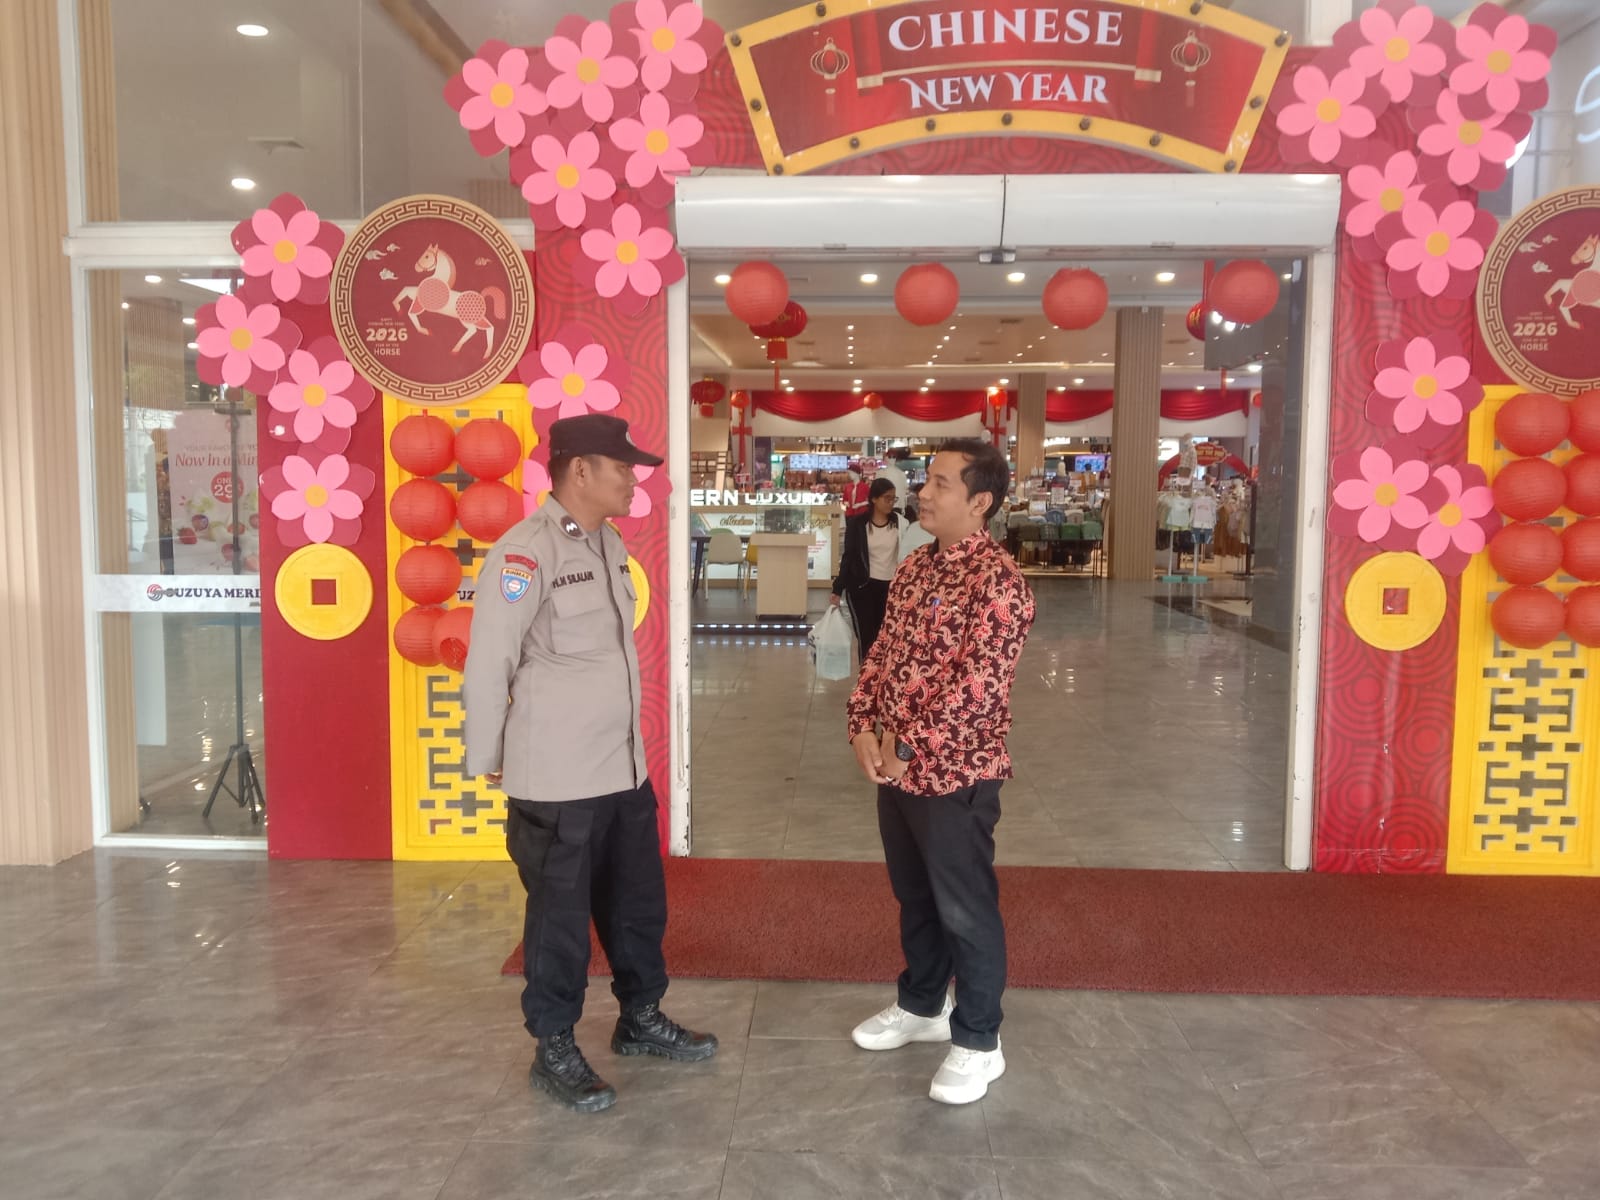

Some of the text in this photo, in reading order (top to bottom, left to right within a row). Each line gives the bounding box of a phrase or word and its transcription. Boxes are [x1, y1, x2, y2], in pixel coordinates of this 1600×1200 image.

[888, 8, 1123, 51] CHINESE
[900, 71, 1109, 111] NEW YEAR
[366, 328, 408, 341] 2026
[1513, 322, 1558, 336] 2026
[374, 348, 400, 356] HORSE
[1520, 343, 1548, 351] HORSE
[809, 443, 836, 454] PIZZA
[175, 452, 205, 467] Now
[690, 489, 739, 506] ERN
